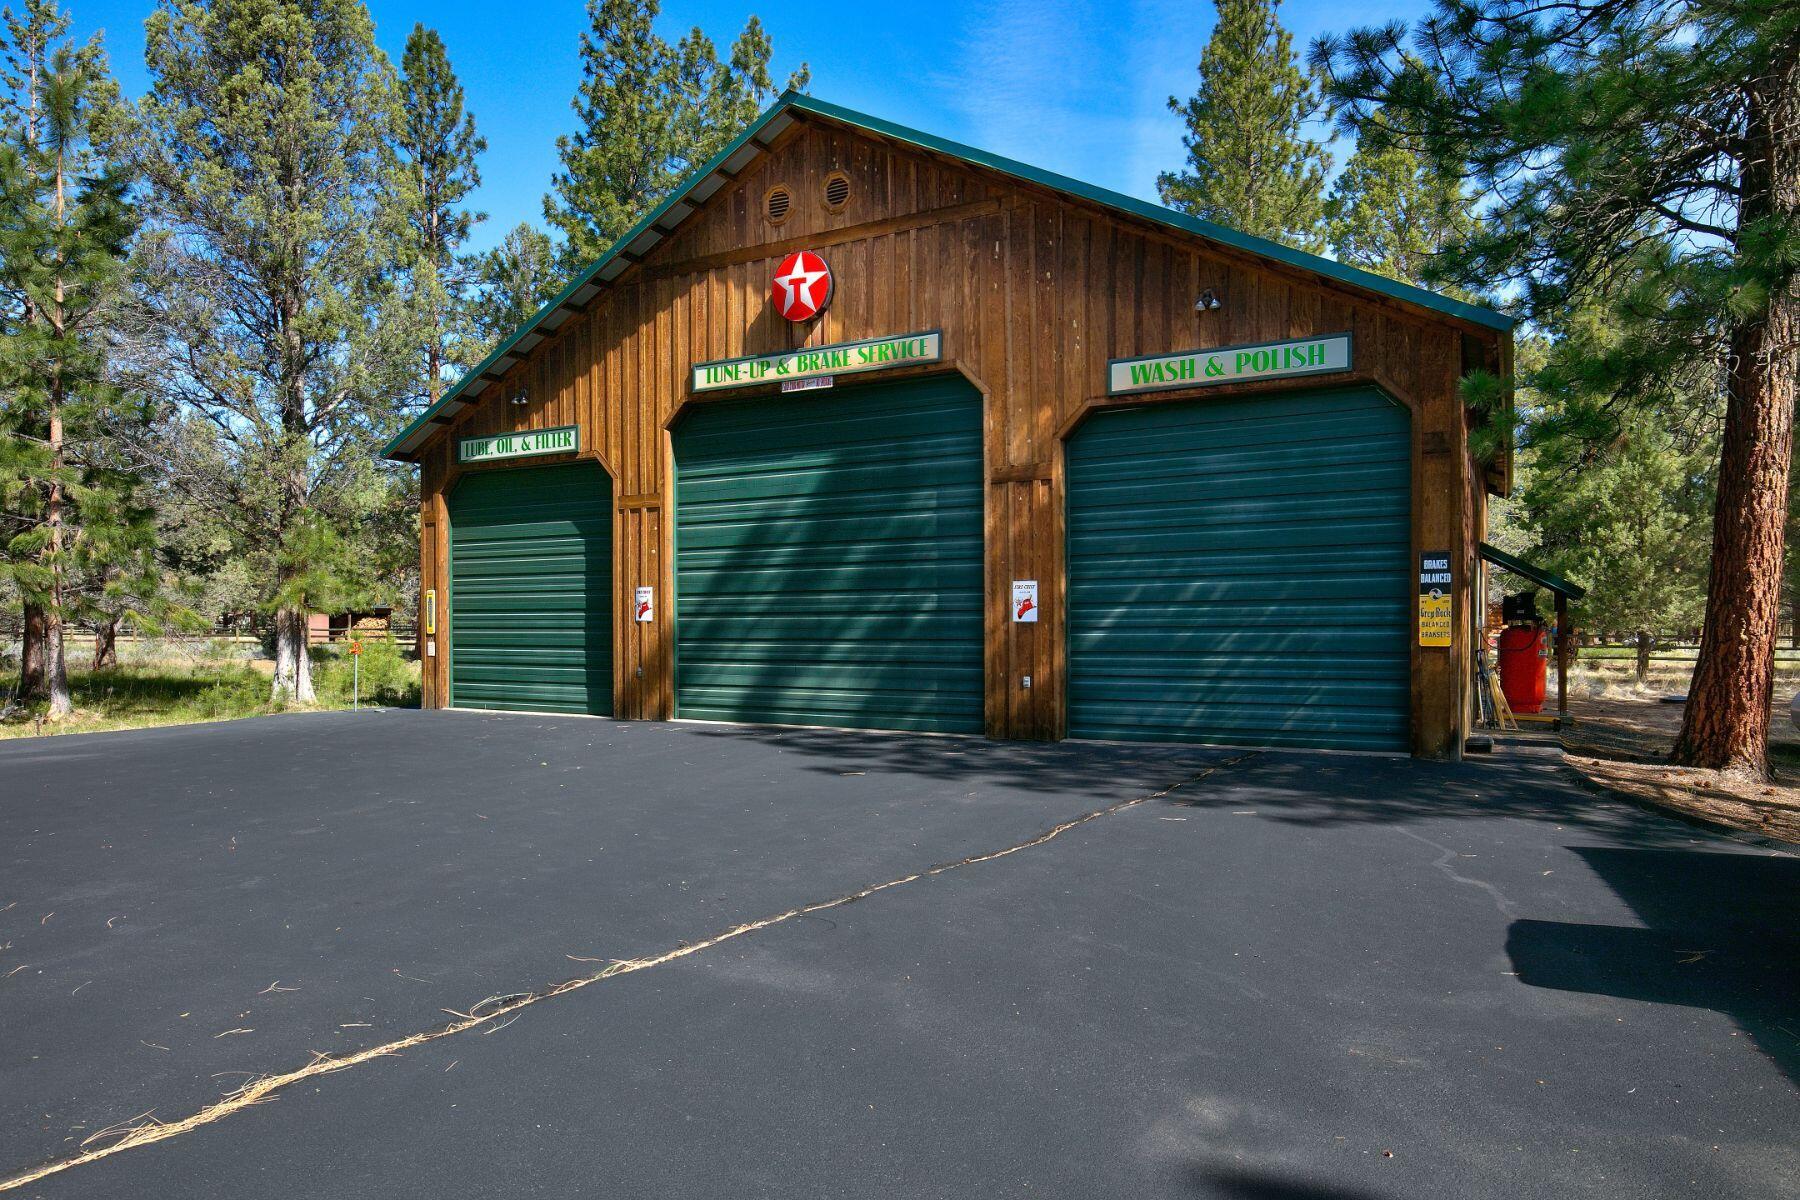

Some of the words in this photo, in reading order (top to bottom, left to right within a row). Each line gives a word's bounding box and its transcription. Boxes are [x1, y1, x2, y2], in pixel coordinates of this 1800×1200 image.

[788, 277, 807, 304] T
[705, 360, 771, 384] TUNE-UP
[776, 355, 790, 376] &
[797, 348, 852, 373] BRAKE
[857, 338, 929, 365] SERVICE
[1130, 359, 1196, 385] WASH
[1204, 355, 1226, 377] &
[1236, 343, 1326, 374] POLISH
[464, 441, 493, 457] LUBE,
[496, 438, 518, 454] OIL,
[521, 436, 532, 451] &
[535, 431, 572, 450] FILTER
[1423, 559, 1448, 569] BRAKES
[1420, 573, 1451, 583] BALANCED
